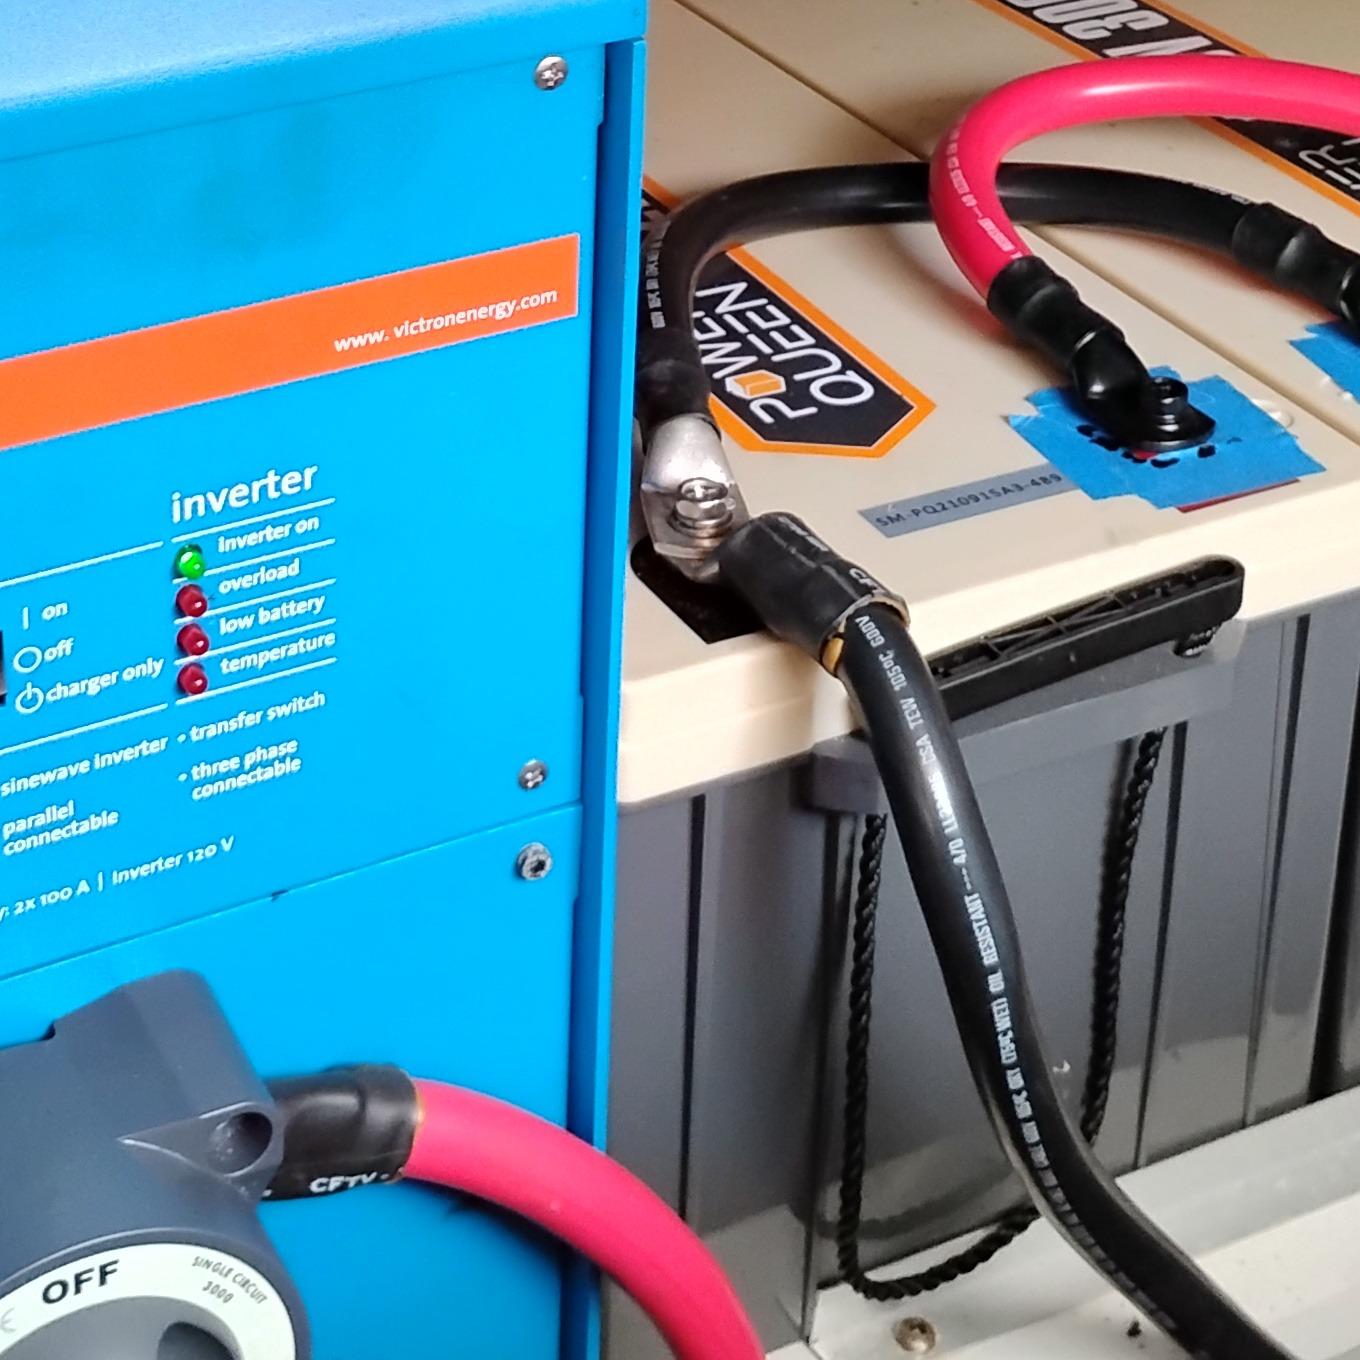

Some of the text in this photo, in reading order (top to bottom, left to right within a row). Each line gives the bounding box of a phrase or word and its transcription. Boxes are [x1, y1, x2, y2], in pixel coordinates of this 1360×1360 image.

[693, 280, 875, 406] QUEEN
[691, 309, 818, 424] POWE
[170, 463, 318, 524] inverter
[217, 516, 320, 553] inverter on
[218, 558, 300, 594] overload
[41, 601, 68, 622] on
[219, 593, 327, 635] low battery
[855, 616, 885, 647] 600V
[44, 635, 74, 663] off
[220, 631, 336, 674] temperature
[45, 655, 166, 706] charger only
[189, 690, 326, 742] transfer switch
[900, 698, 924, 730] TEW
[0, 736, 169, 797] sinewave inverter
[191, 739, 298, 782] three phase
[191, 756, 302, 802] connectable
[2, 800, 75, 840] parallel
[2, 809, 119, 857] connectable
[40, 886, 73, 907] 100
[75, 878, 92, 896] A
[186, 844, 218, 863] 120
[220, 834, 235, 852] V
[41, 1259, 120, 1305] OFF
[191, 1255, 268, 1306] SINGLE CIRCUIT
[201, 1280, 235, 1305] 3000
